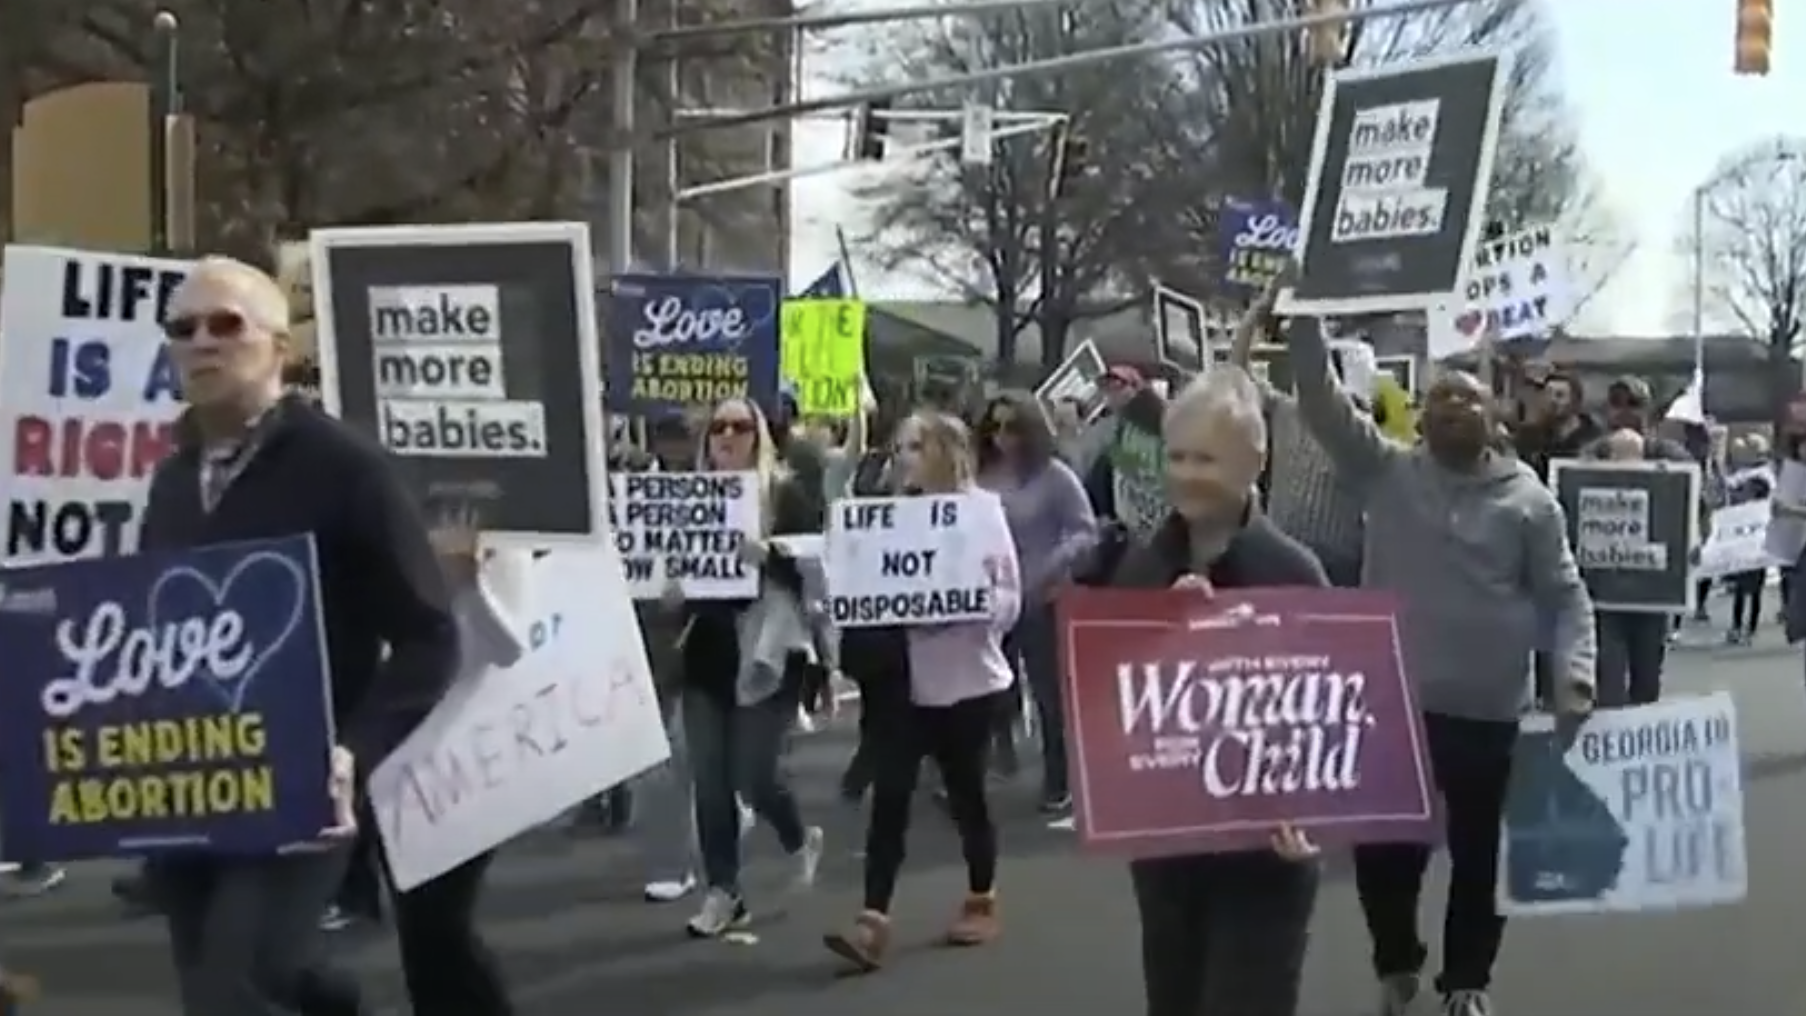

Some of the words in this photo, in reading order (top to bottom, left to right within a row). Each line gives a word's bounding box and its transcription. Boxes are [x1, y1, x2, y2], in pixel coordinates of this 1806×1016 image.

[1355, 110, 1429, 144] make
[1348, 155, 1422, 186] more
[1338, 202, 1437, 236] babies.
[376, 293, 490, 336] make
[633, 296, 746, 348] Love
[49, 338, 111, 398] IS
[144, 344, 183, 401] A
[379, 354, 491, 386] more
[632, 351, 653, 375] IS
[659, 353, 747, 377] ENDING
[632, 377, 747, 400] ABORTION
[386, 404, 541, 450] babies.
[15, 414, 178, 480] RIGH
[8, 500, 132, 556] NOT
[627, 502, 726, 527] PERSON
[843, 503, 895, 530] LIFE
[930, 501, 957, 527] IS
[645, 530, 745, 553] MATTER
[881, 549, 936, 577] NOT
[833, 588, 988, 621] DISPOSABLE
[41, 601, 253, 716] Love
[43, 728, 86, 771] IS
[98, 713, 266, 767] ENDING
[1204, 724, 1361, 797] Child
[49, 767, 273, 824] ABORTION
